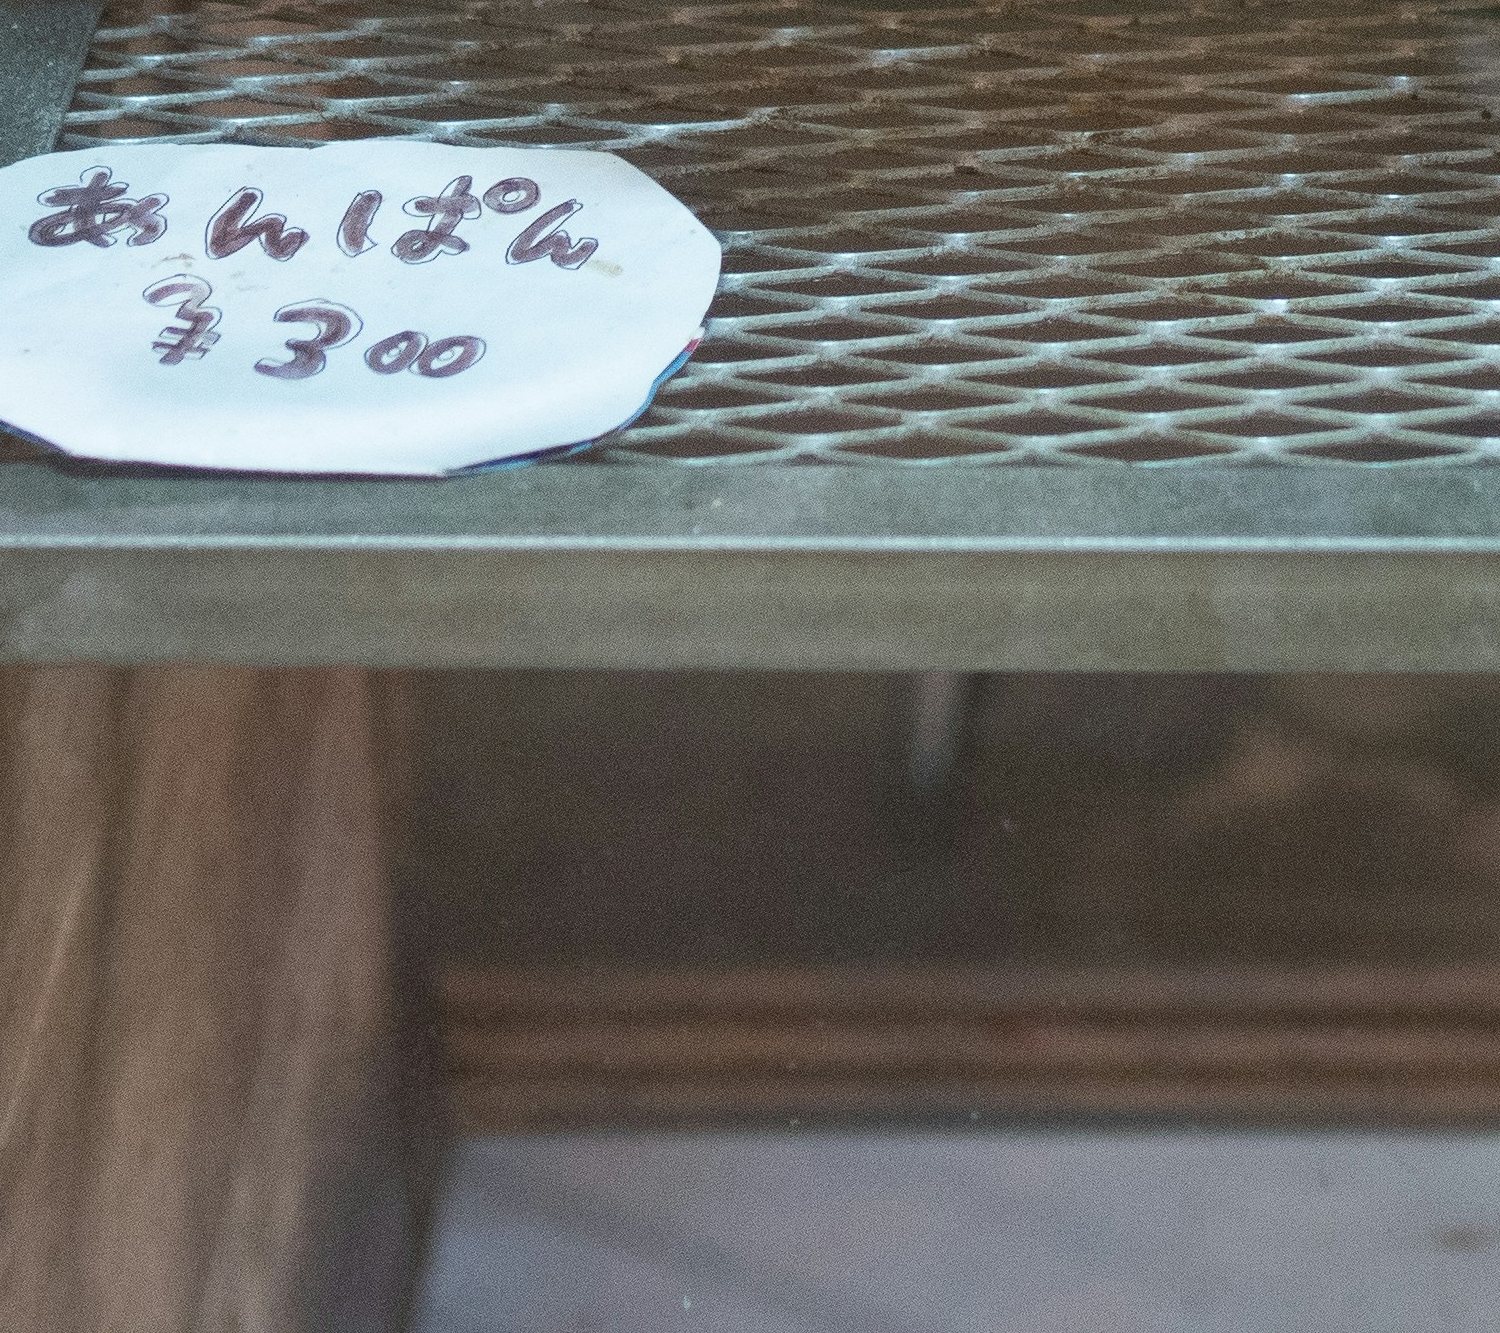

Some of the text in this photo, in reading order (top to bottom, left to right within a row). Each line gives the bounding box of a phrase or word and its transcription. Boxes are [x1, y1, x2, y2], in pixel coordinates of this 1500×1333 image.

[27, 165, 601, 271] あんぱん
[141, 273, 489, 381] ¥300
